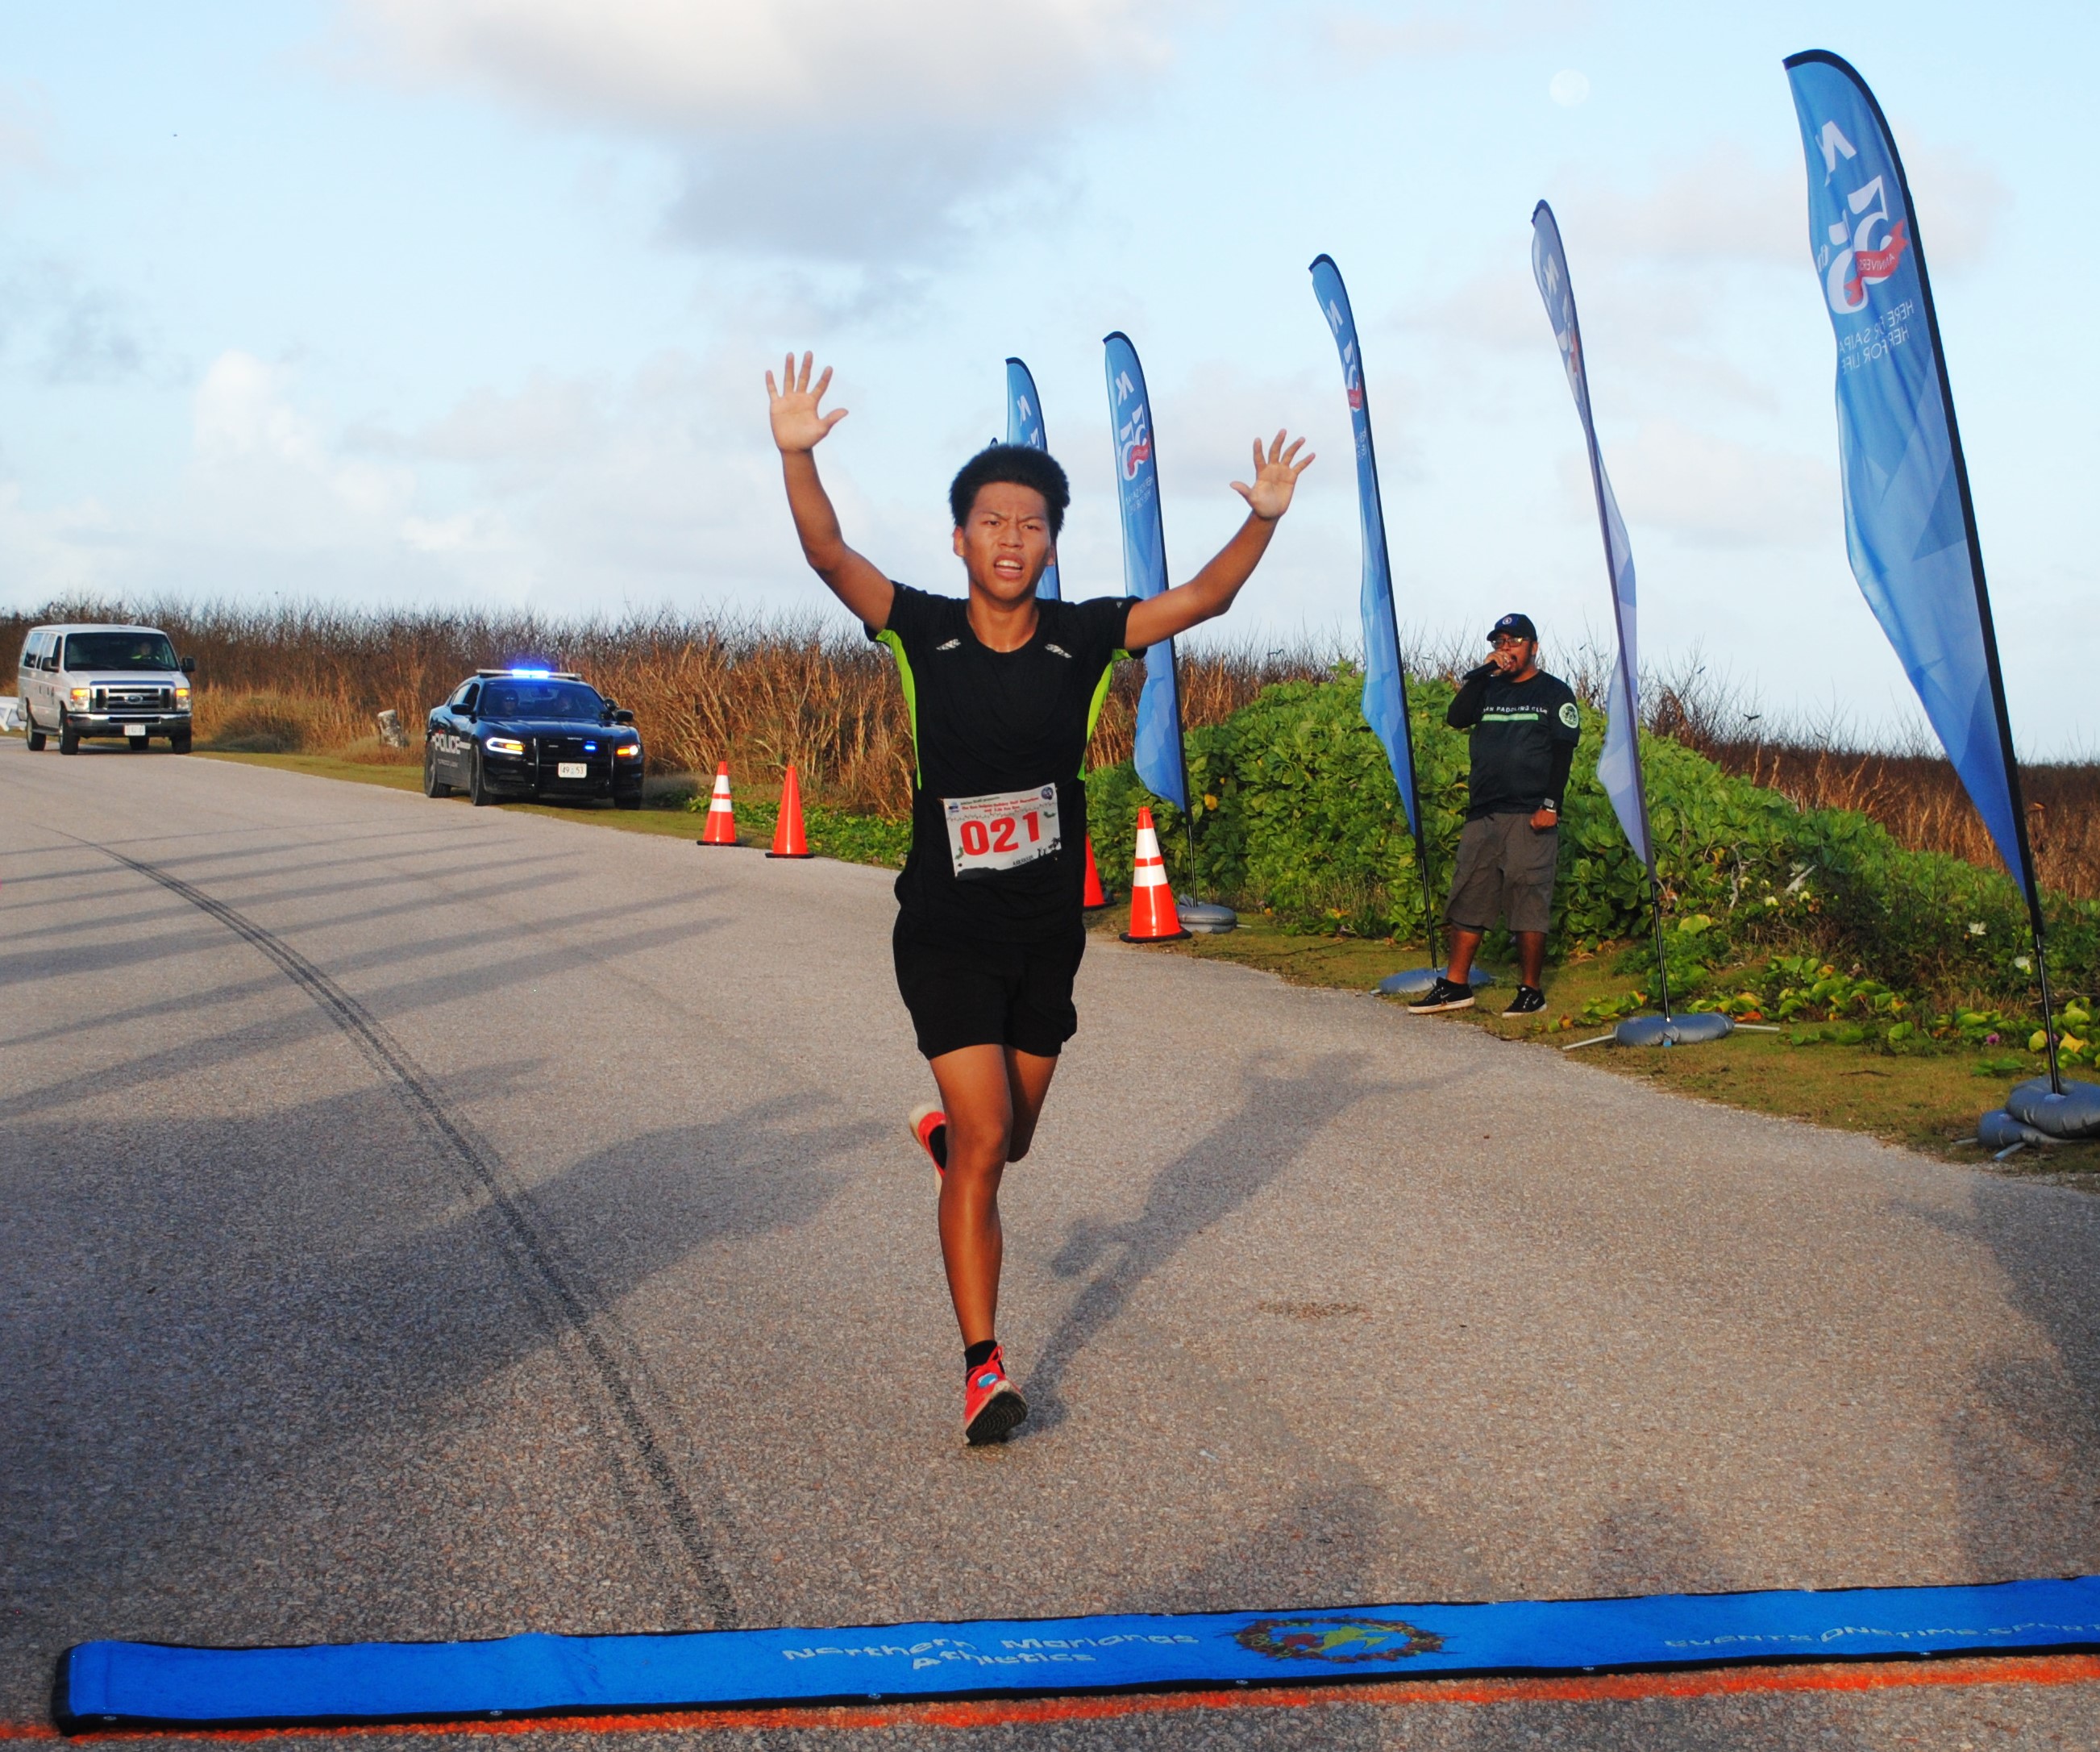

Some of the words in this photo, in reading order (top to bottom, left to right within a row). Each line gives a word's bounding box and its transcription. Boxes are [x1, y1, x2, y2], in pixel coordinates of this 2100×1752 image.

[435, 733, 461, 755] POLICE
[959, 810, 1040, 856] 021
[782, 1638, 977, 1661] Northern
[1000, 1634, 1200, 1649] Marianas
[913, 1650, 1097, 1670] Athletics
